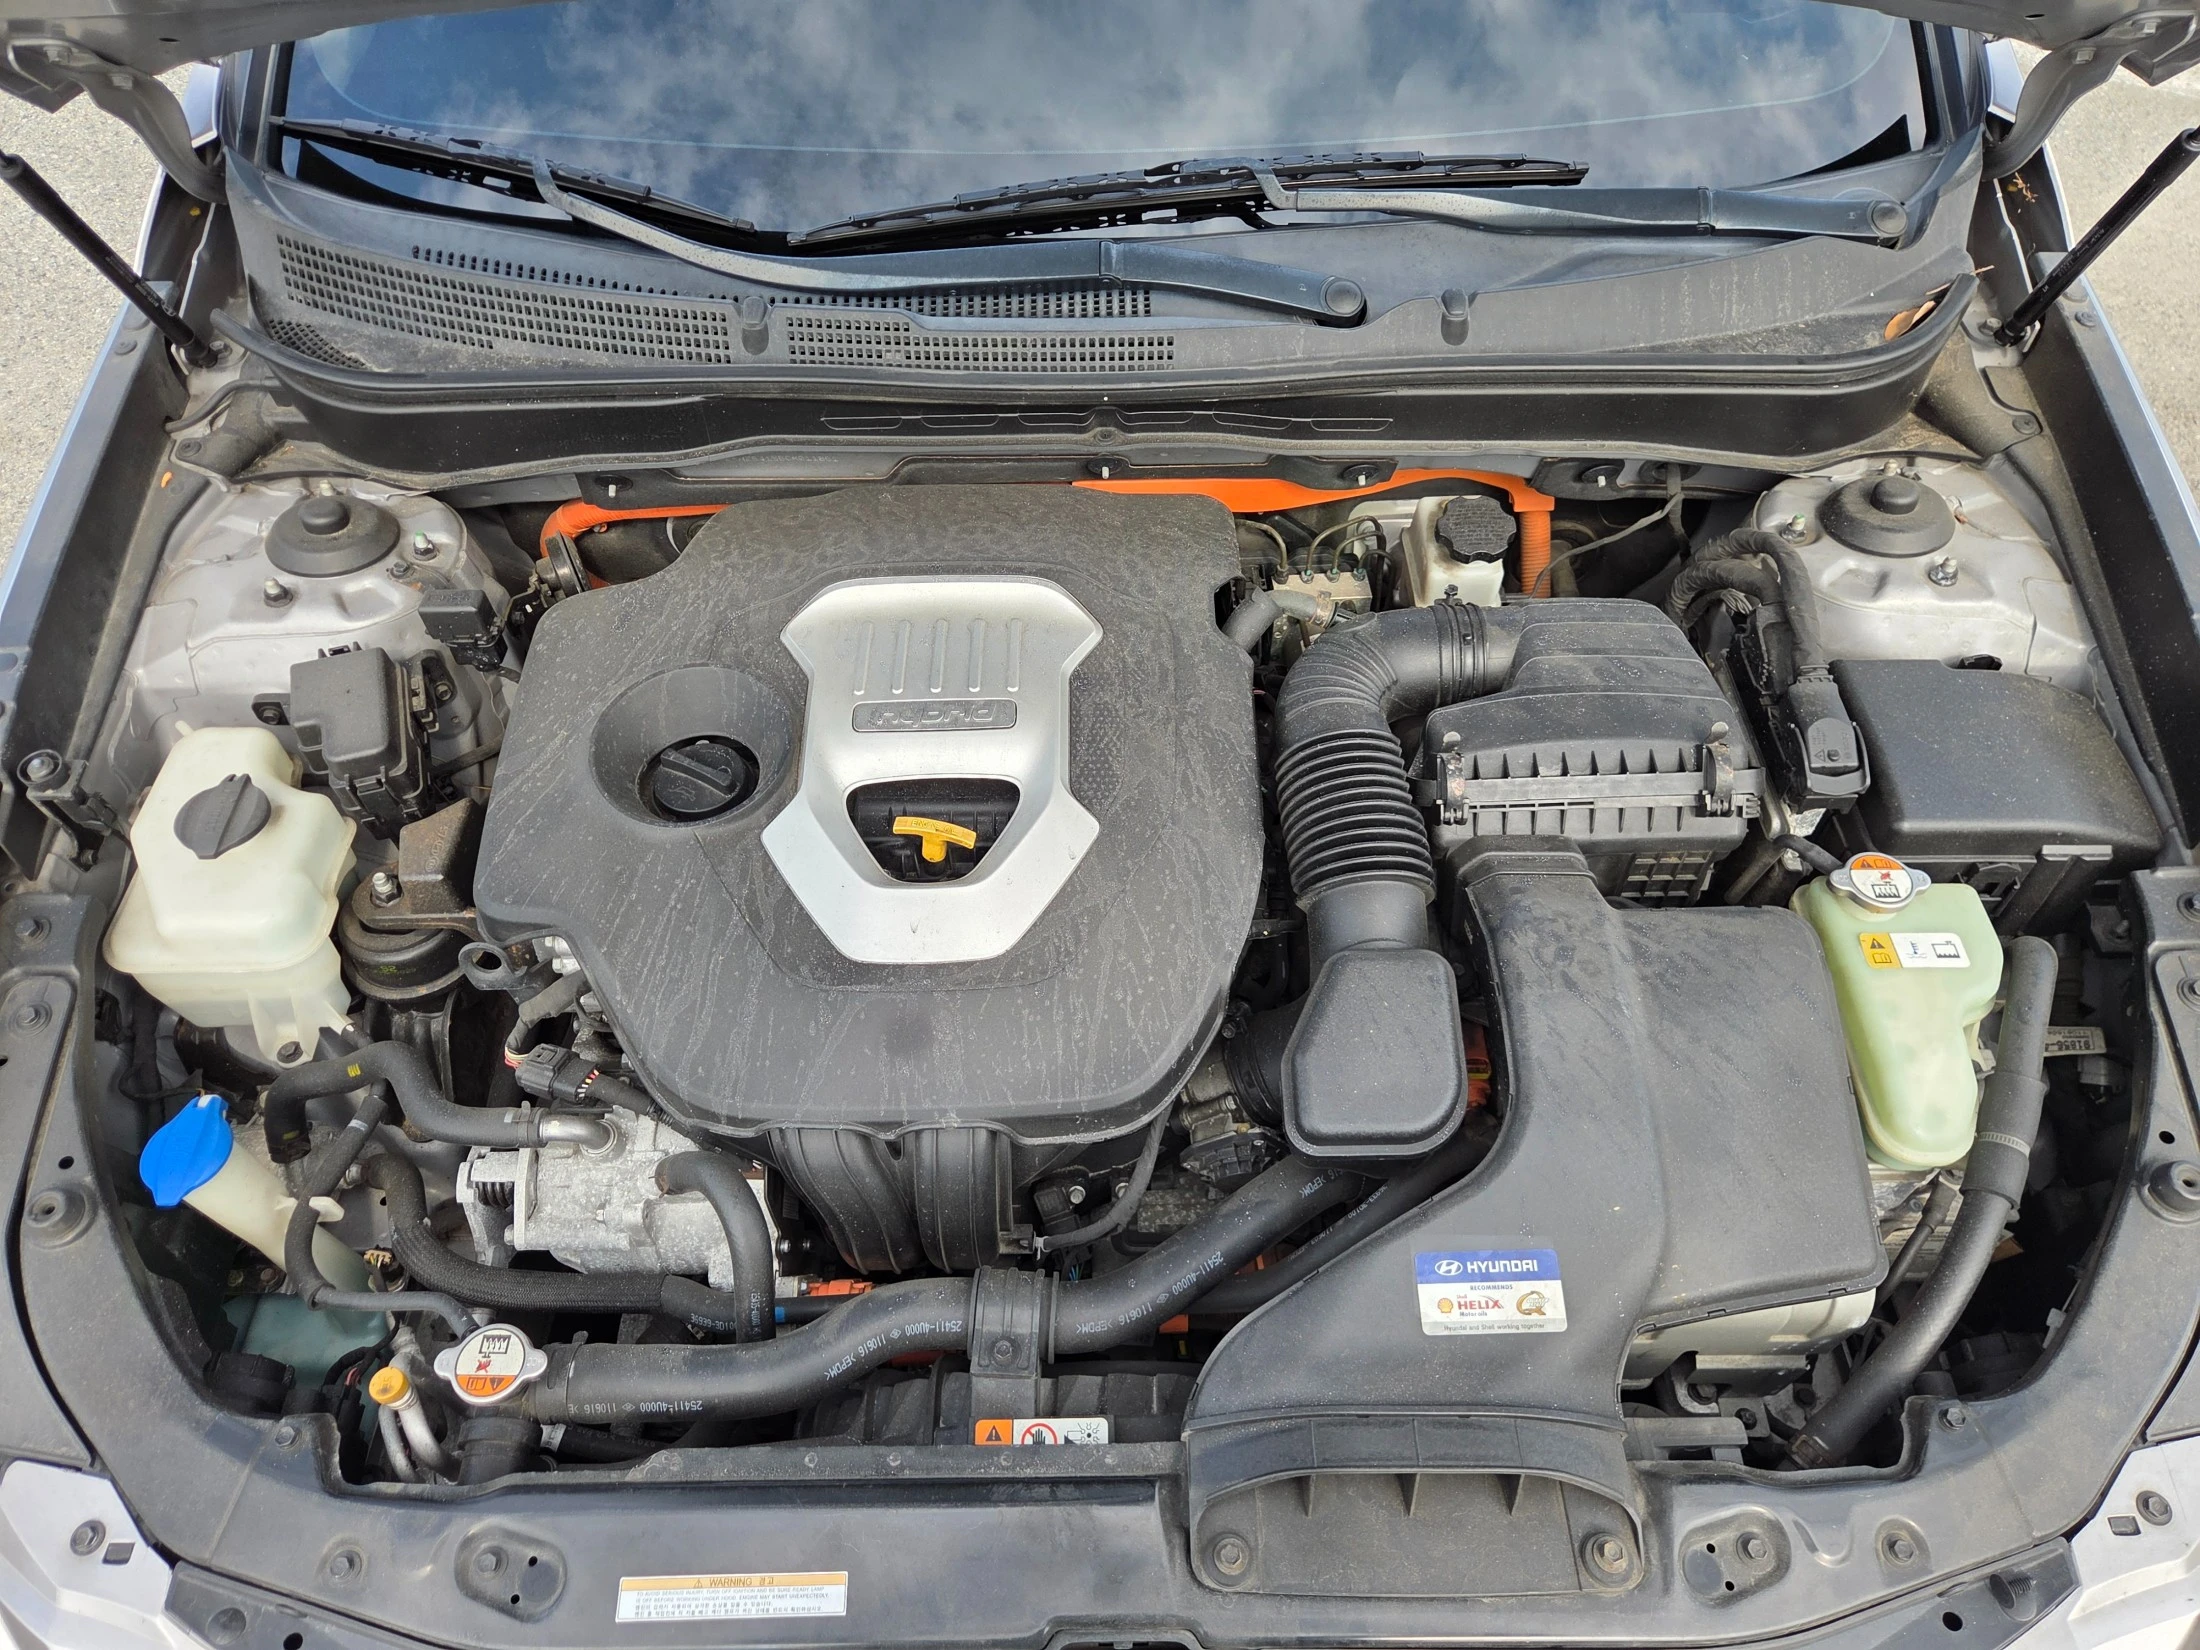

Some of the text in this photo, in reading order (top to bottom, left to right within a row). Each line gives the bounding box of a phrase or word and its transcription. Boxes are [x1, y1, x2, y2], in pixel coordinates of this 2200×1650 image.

[876, 703, 997, 727] hybrid
[911, 819, 941, 830] ENGINE
[1467, 1259, 1538, 1273] HYUNDAI
[1076, 1250, 1224, 1334] 25411-4U000 110616 >EPDM<
[1457, 1299, 1502, 1310] HELIX
[1444, 1324, 1468, 1332] Hyundai
[1497, 1323, 1520, 1331] working
[1521, 1322, 1545, 1331] together
[824, 1320, 962, 1381] 25411-4U000 110616 >EPDM<
[584, 1402, 616, 1413] 110616
[639, 1400, 703, 1412] 25411-4U000
[708, 1577, 752, 1587] WARNING
